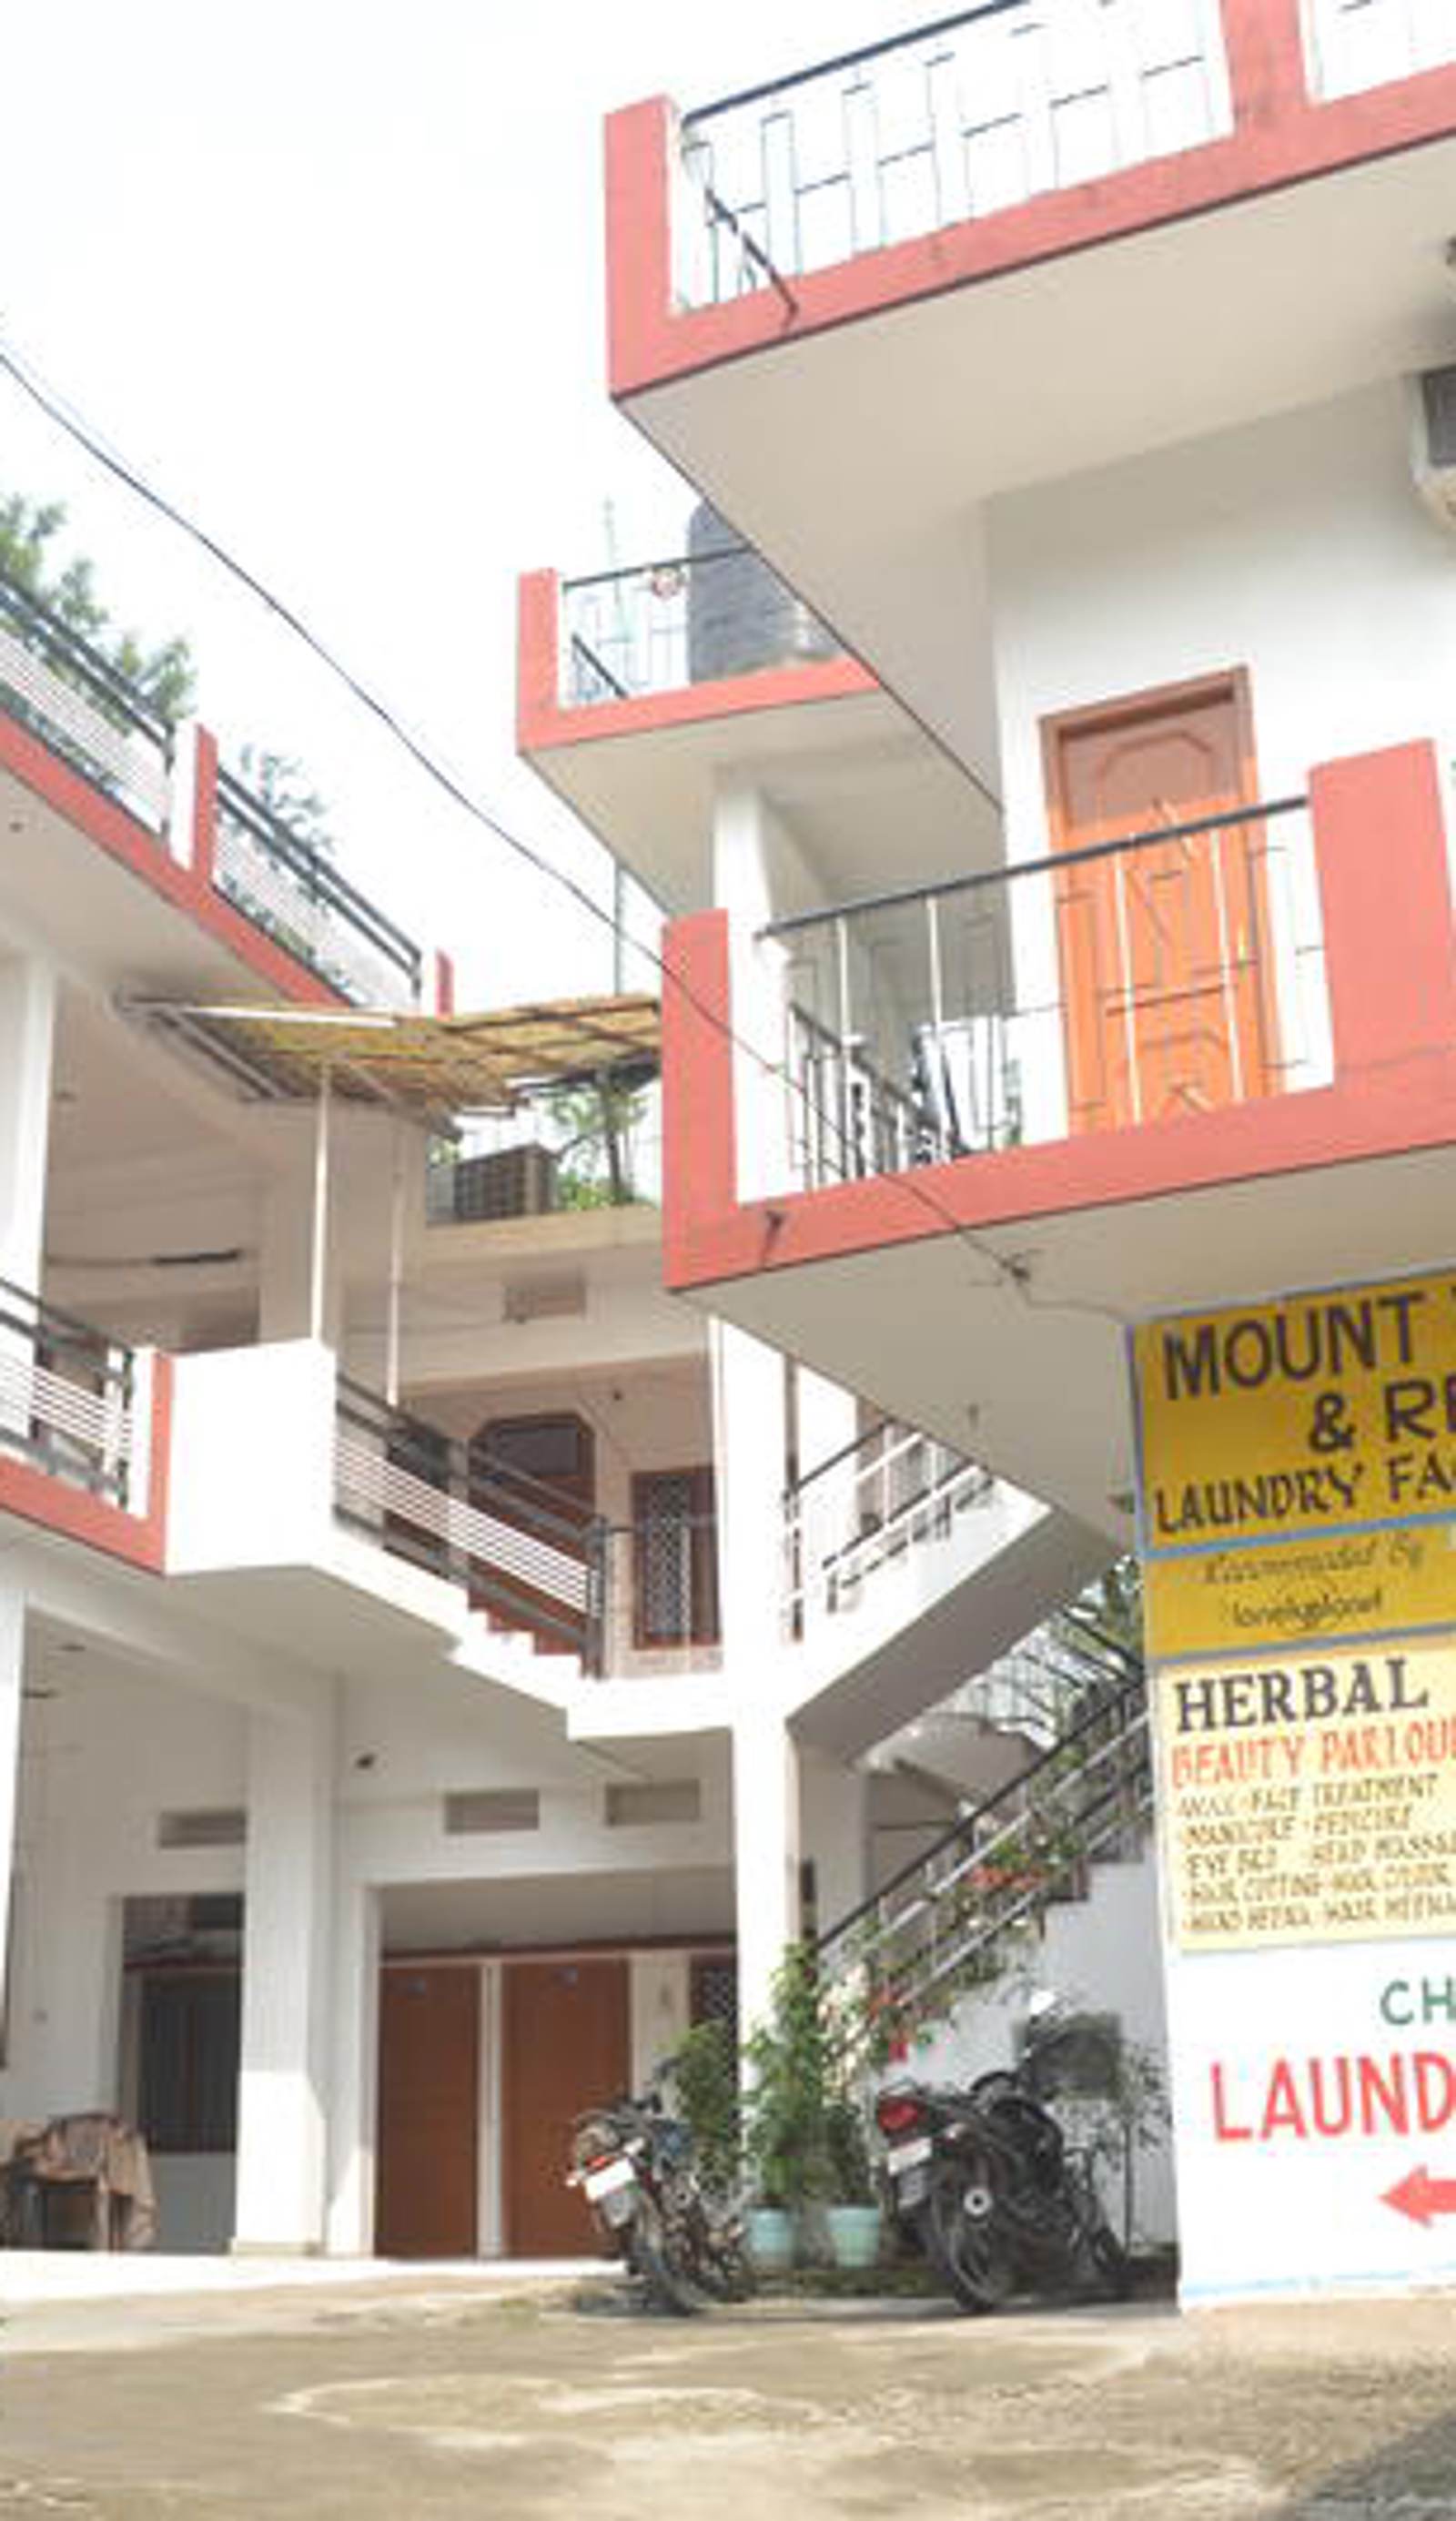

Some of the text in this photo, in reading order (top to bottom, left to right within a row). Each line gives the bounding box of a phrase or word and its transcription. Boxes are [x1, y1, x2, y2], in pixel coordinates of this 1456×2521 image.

[1162, 1291, 1428, 1402] MOUNT
[1309, 1372, 1456, 1453] & R
[1155, 1450, 1456, 1533] LAUNDRY FA
[1173, 1656, 1430, 1733] HERBAL
[1172, 1716, 1456, 1789] BEAUTY PARLOU
[1313, 1771, 1438, 1807] TREATMENT
[1380, 1976, 1456, 2025] CH
[1210, 2051, 1456, 2141] LAUND
